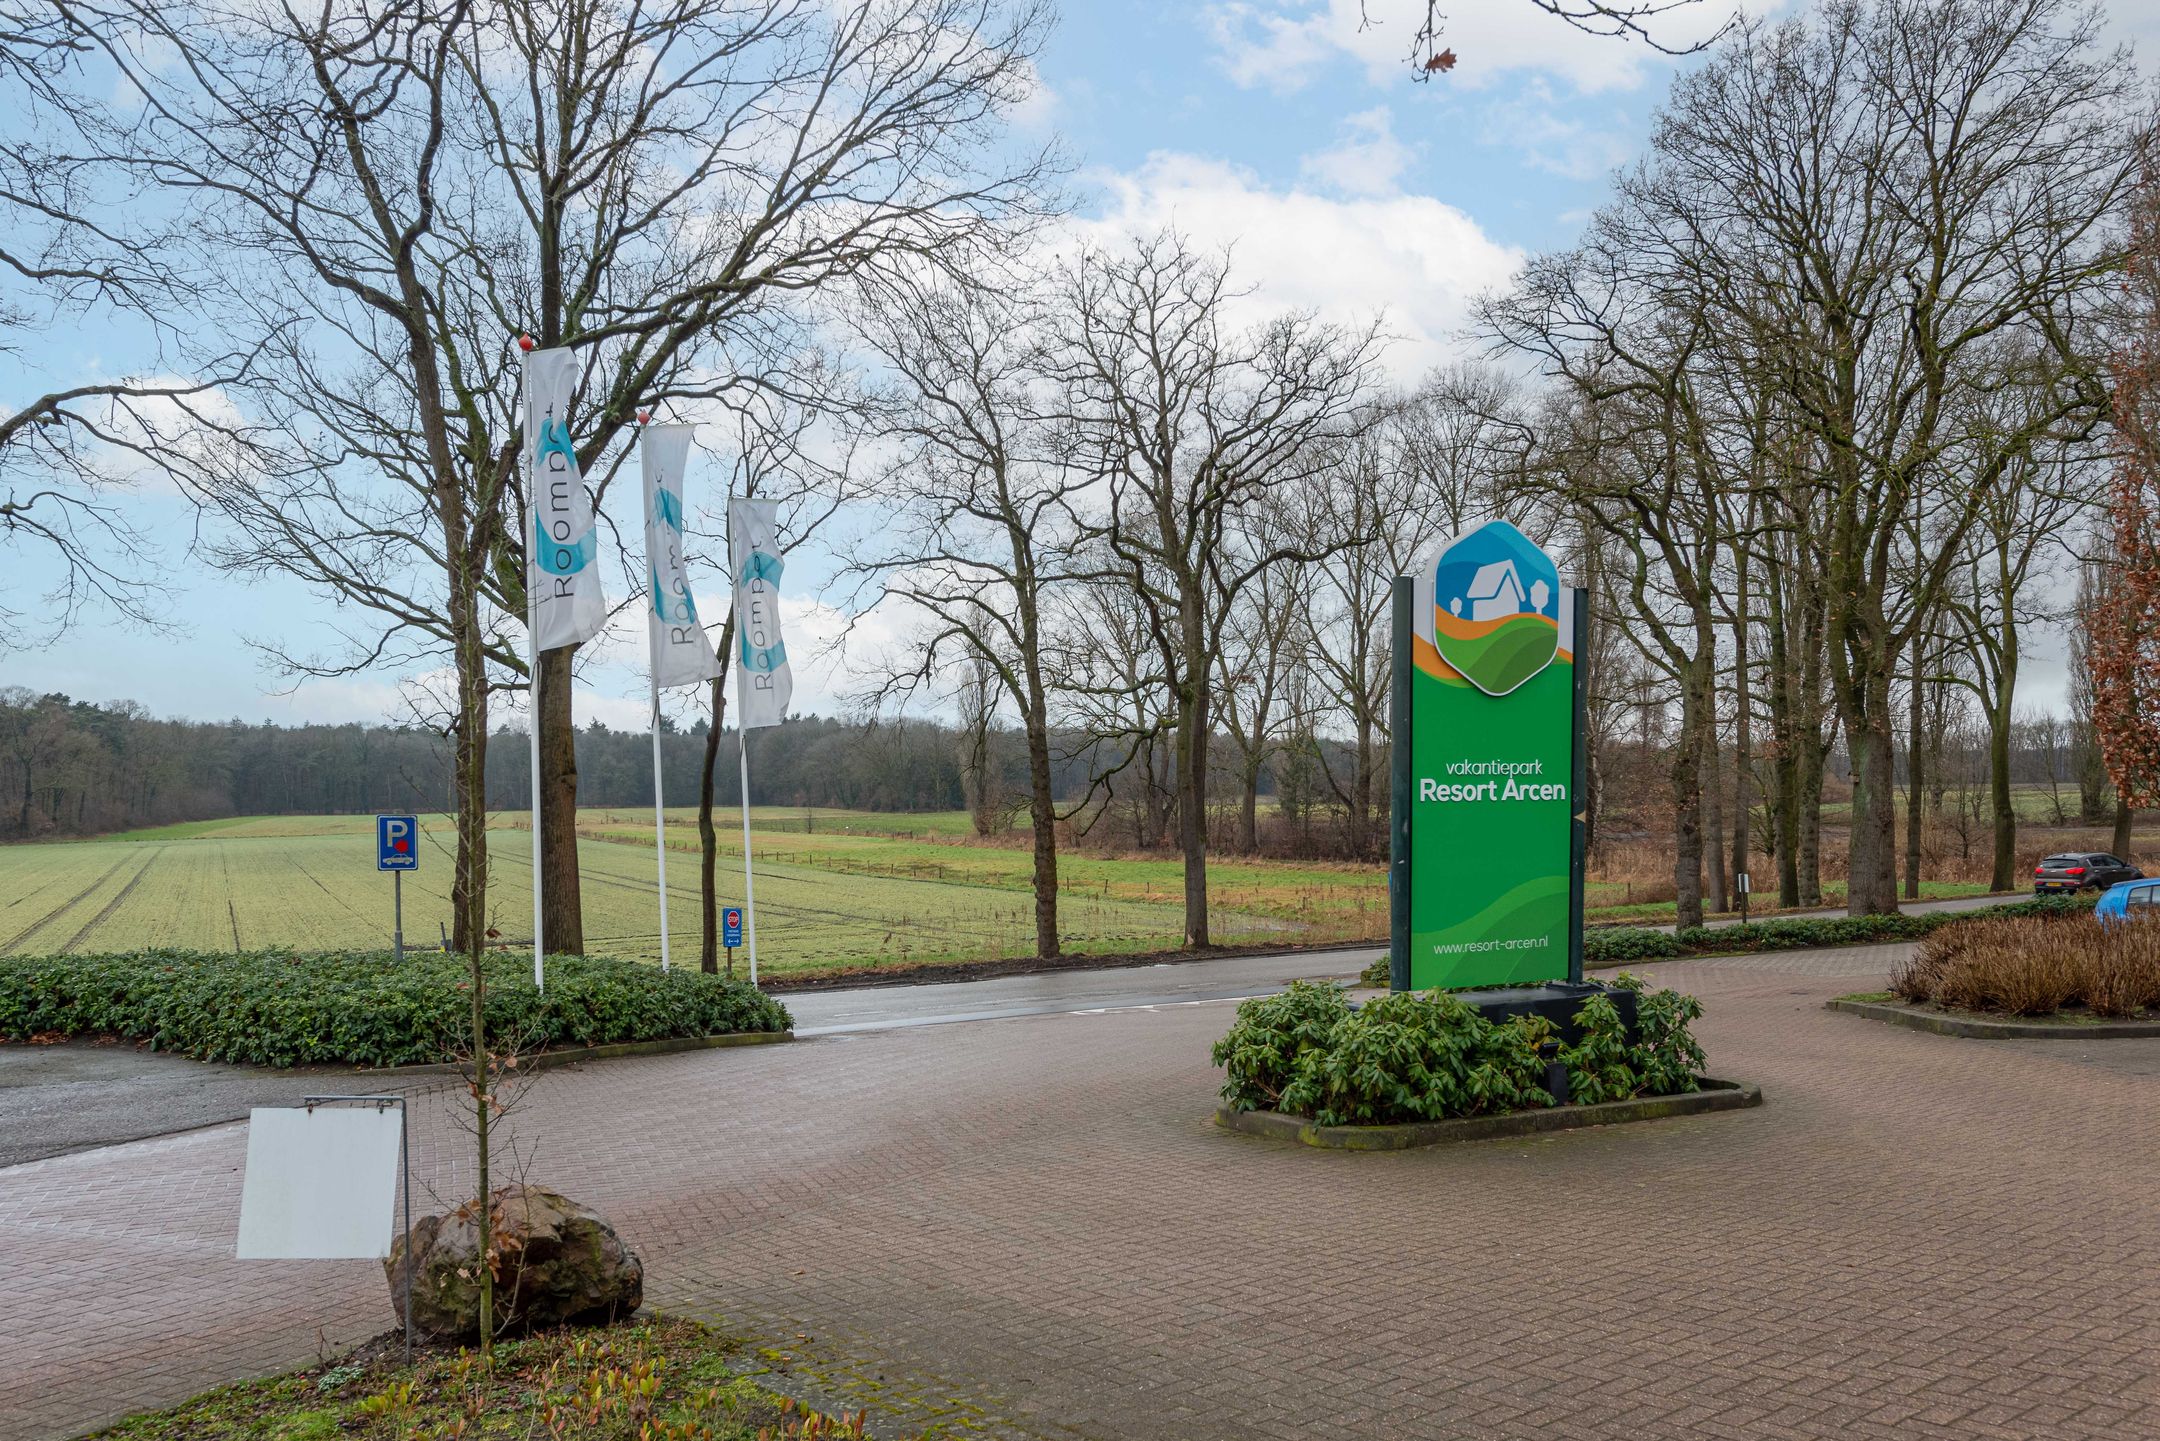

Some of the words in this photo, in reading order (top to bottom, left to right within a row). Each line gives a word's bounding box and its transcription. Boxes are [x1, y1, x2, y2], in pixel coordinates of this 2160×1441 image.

[1446, 759, 1543, 778] vakantiepark
[1419, 778, 1498, 801] Resort
[1501, 778, 1566, 801] Arcen
[387, 820, 408, 847] P
[1434, 936, 1548, 954] www.resort-arcen.nl
